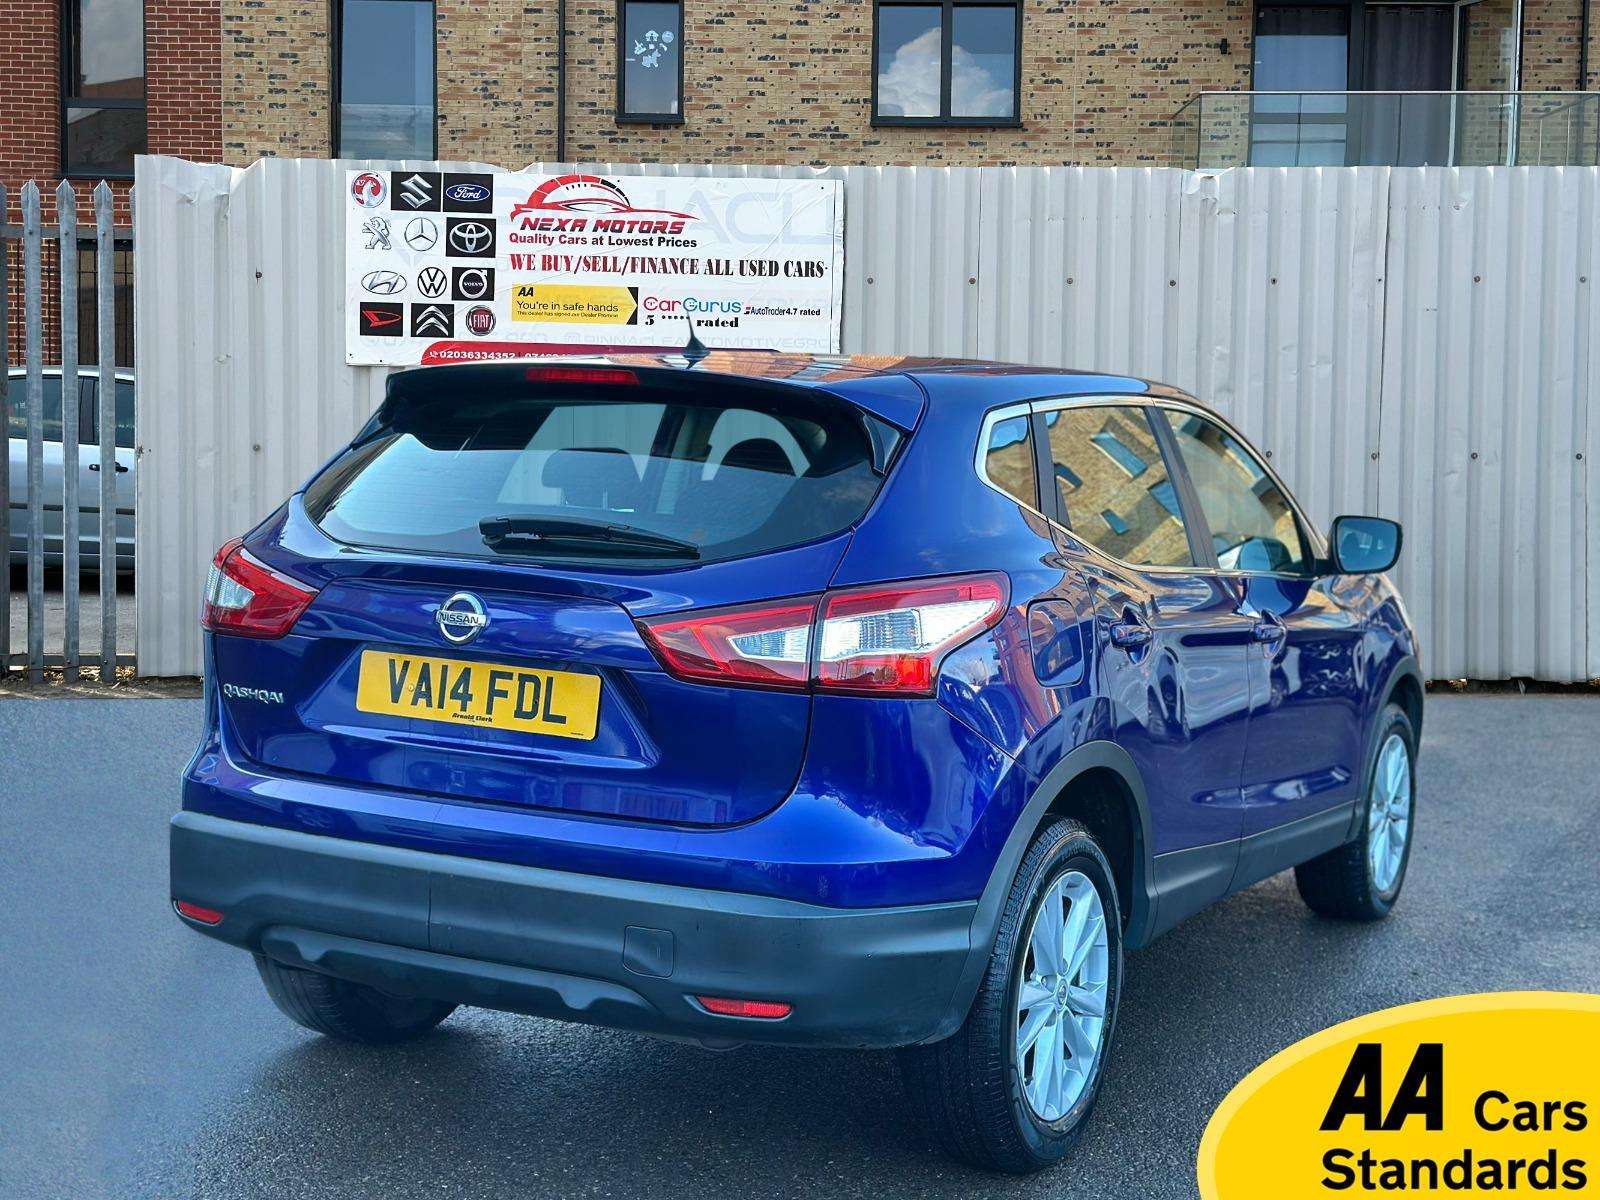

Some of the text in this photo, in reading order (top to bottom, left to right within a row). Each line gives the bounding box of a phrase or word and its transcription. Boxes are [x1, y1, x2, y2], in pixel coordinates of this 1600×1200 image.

[454, 186, 482, 199] Ford
[519, 217, 686, 235] NEXA MOTORS
[509, 232, 698, 248] Quality Cars at Lowest Prices
[509, 253, 825, 278] WE BUY/SELL/FINANCE ALL USED CARS
[517, 286, 534, 297] AA
[516, 300, 619, 312] You're in safe hands
[643, 296, 742, 313] CarGurus
[799, 307, 821, 316] rated
[473, 314, 490, 328] FIAT
[645, 314, 739, 328] 5 rated
[440, 611, 479, 624] NISSAN
[223, 683, 284, 704] QASHQAI
[387, 657, 567, 725] VA14 FDL
